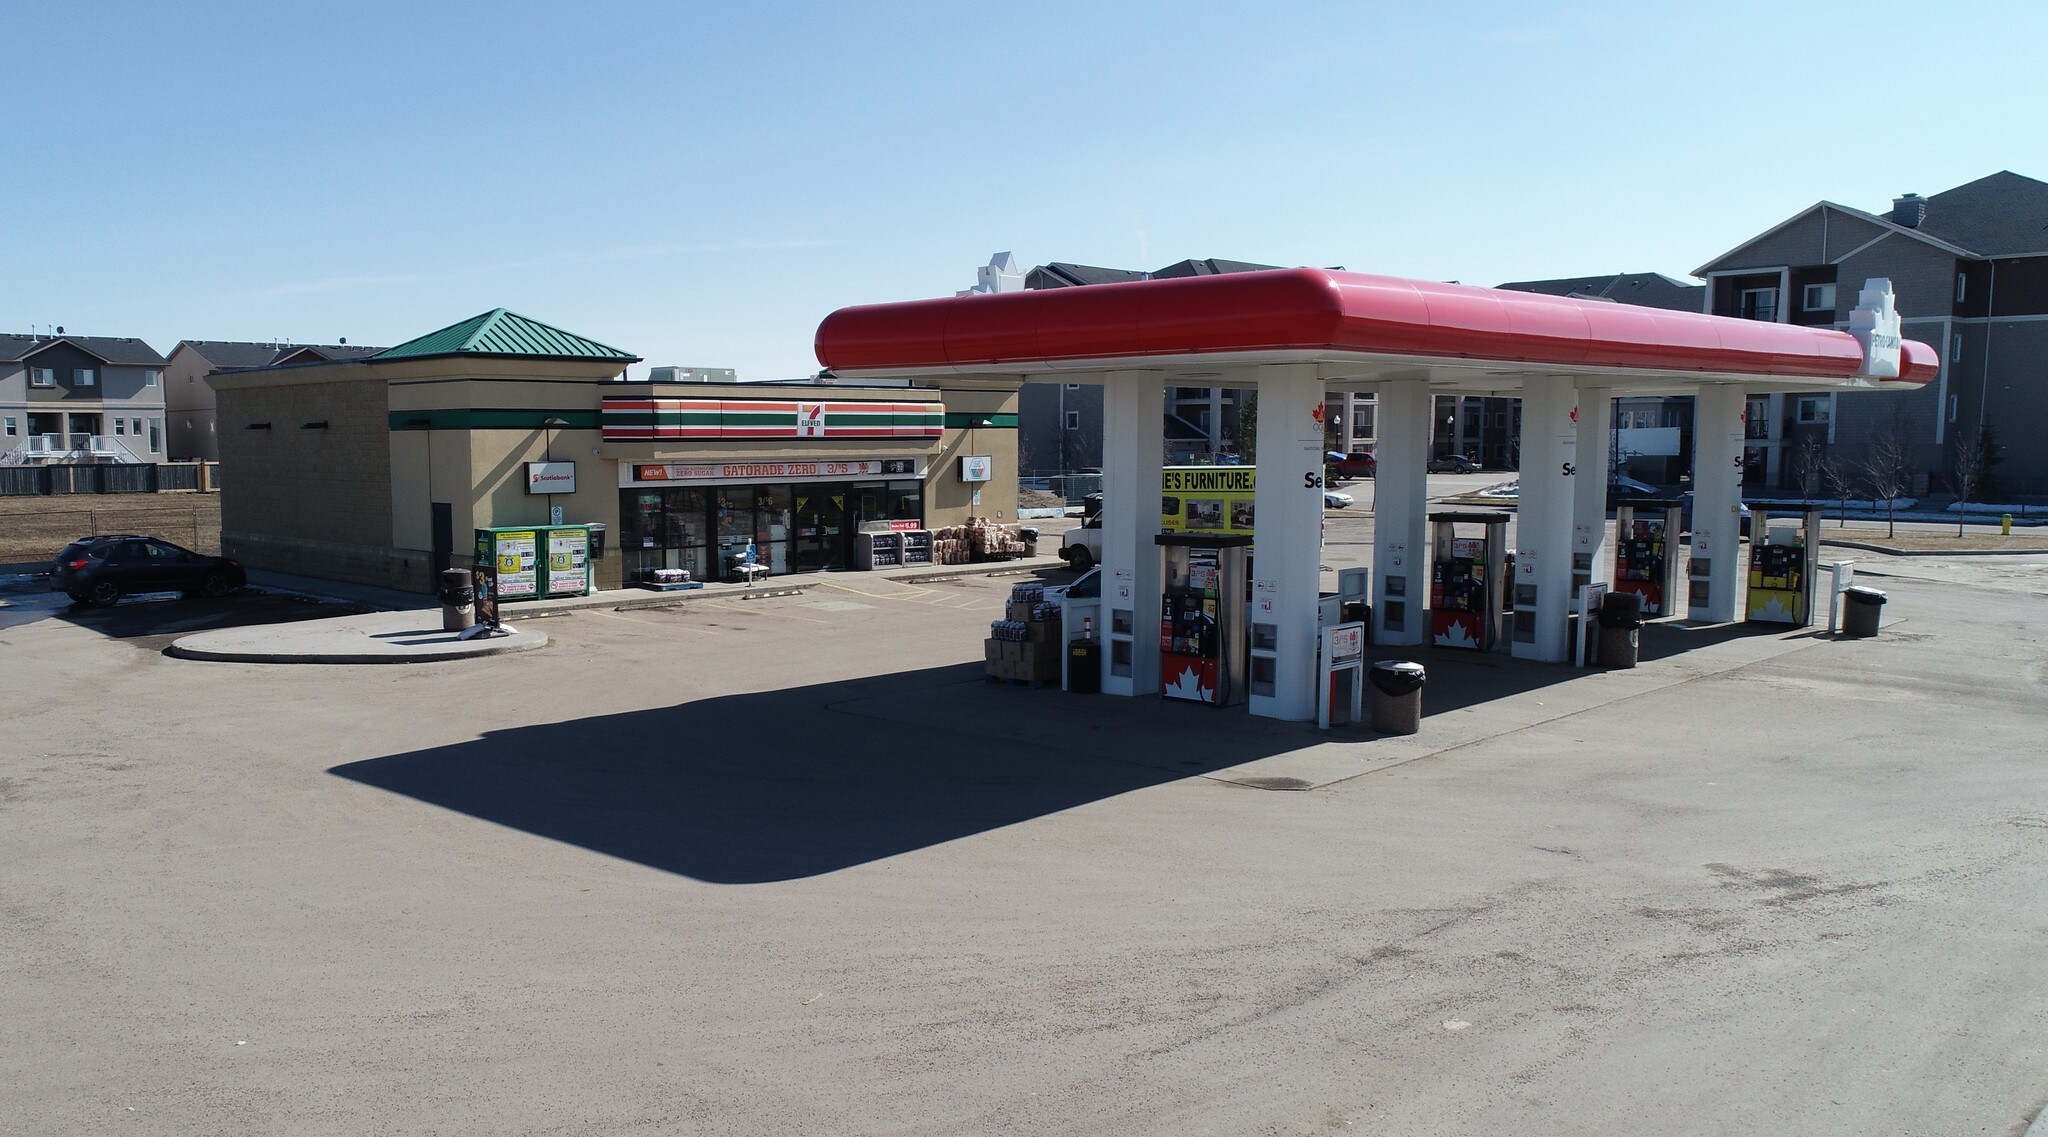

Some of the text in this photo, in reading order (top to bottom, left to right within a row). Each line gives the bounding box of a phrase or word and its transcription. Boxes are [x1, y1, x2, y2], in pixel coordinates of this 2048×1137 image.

[723, 465, 784, 477] GATORADE
[788, 464, 816, 475] ZERO
[540, 474, 570, 482] Scotiabank
